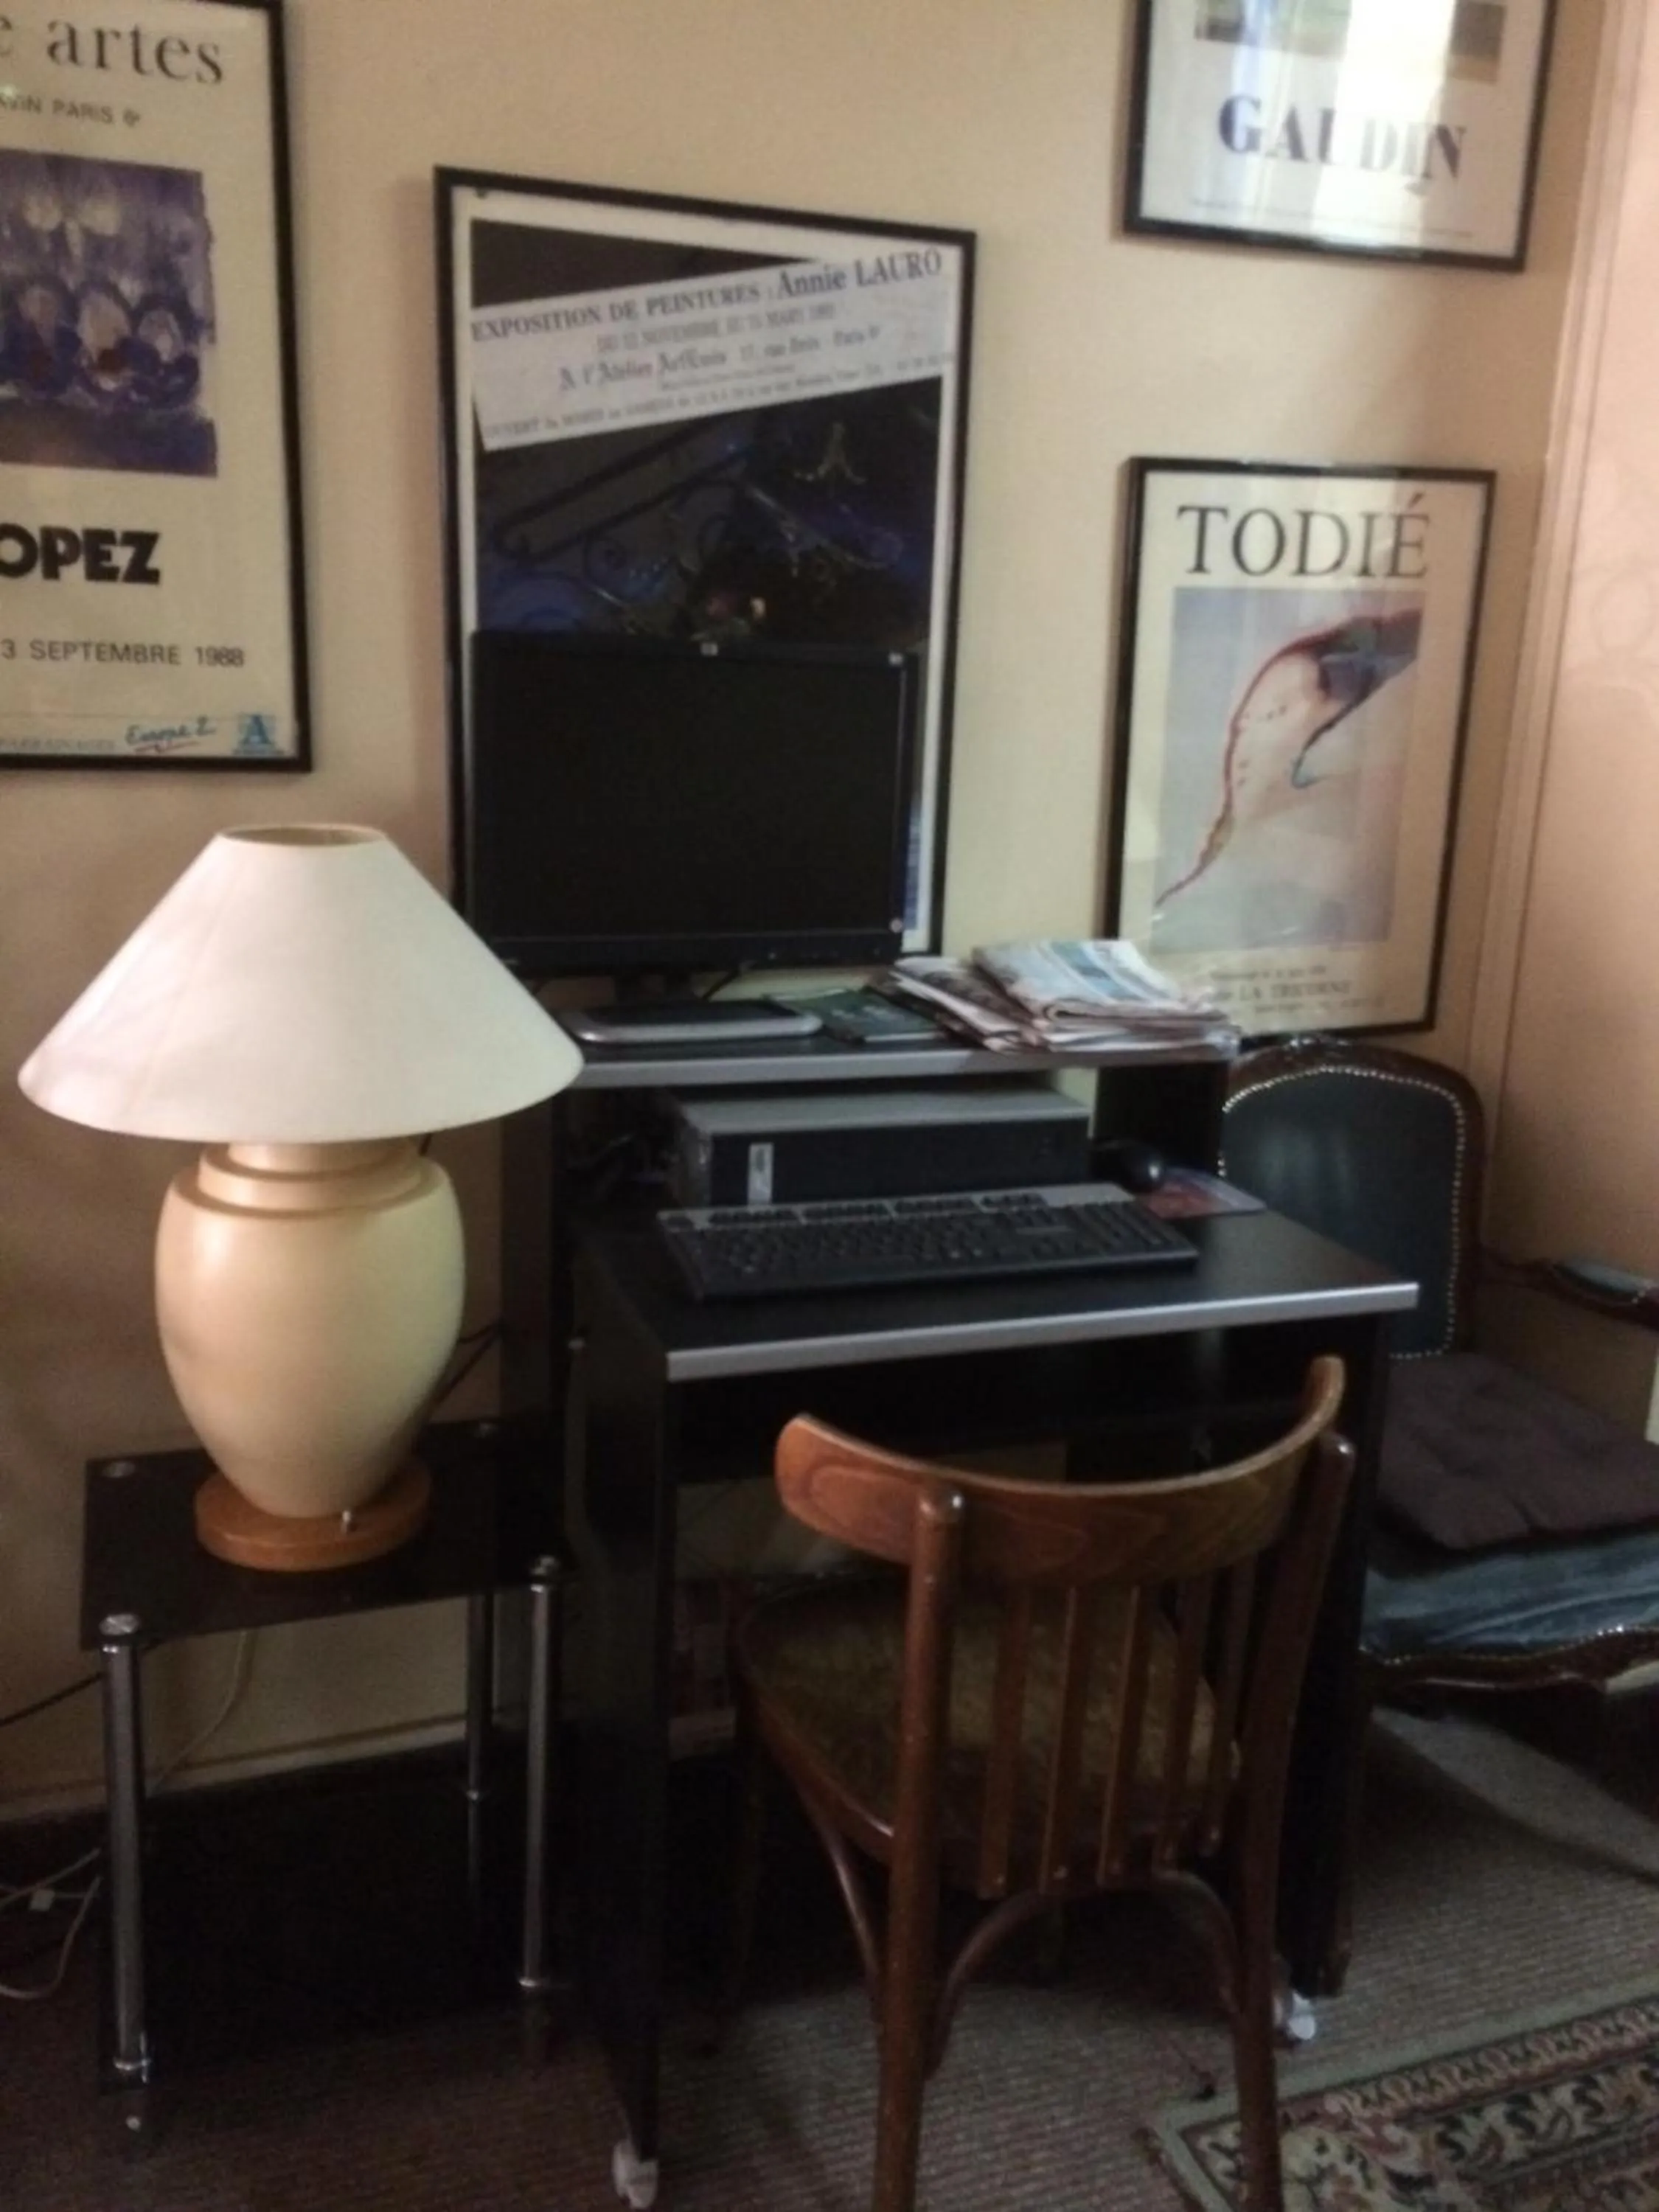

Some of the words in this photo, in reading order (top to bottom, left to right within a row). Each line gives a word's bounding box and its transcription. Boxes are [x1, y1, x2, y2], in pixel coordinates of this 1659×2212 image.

[47, 20, 224, 85] artes
[52, 97, 114, 125] PARIS
[472, 304, 602, 342] EXPOSITION
[609, 299, 639, 323] DE
[647, 282, 759, 317] PEINTURES
[778, 263, 847, 300] Annie
[855, 248, 942, 288] LAURO
[0, 522, 160, 585] OPEZ
[1177, 491, 1430, 580] TODIÉ
[29, 639, 182, 666] SEPTEMBRE
